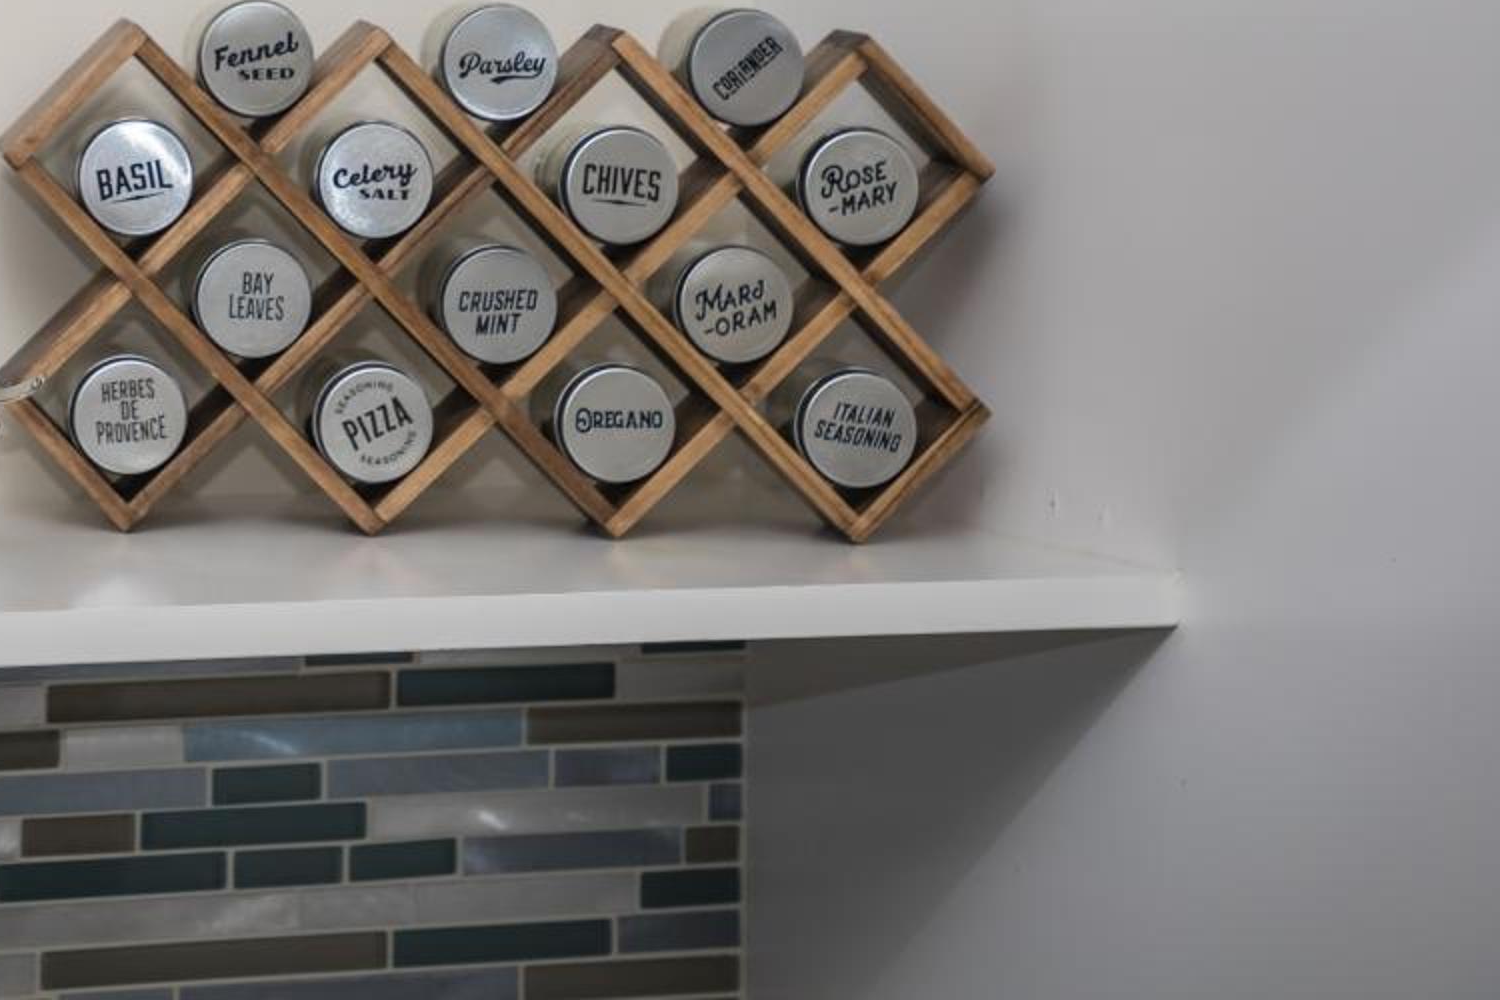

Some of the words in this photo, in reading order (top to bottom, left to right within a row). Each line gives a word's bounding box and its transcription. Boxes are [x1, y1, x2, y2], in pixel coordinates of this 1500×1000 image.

[214, 32, 299, 71] Fennel
[238, 67, 295, 81] SEED
[459, 51, 547, 80] Parsley
[96, 159, 173, 202] BASIL
[332, 161, 418, 189] Celery
[582, 163, 661, 203] CHIVES
[358, 188, 412, 201] SALT
[242, 271, 275, 295] BAY
[228, 293, 285, 322] LEAVES
[458, 288, 539, 313] CRUSHED
[475, 312, 522, 336] MINT
[101, 377, 156, 400] HERBES
[120, 400, 139, 420] DE
[341, 396, 413, 451] PIZZA
[575, 407, 663, 433] OREGANO
[832, 400, 896, 427] ITALIAN
[96, 415, 167, 445] PROVENCE
[813, 420, 902, 454] SEASONING
